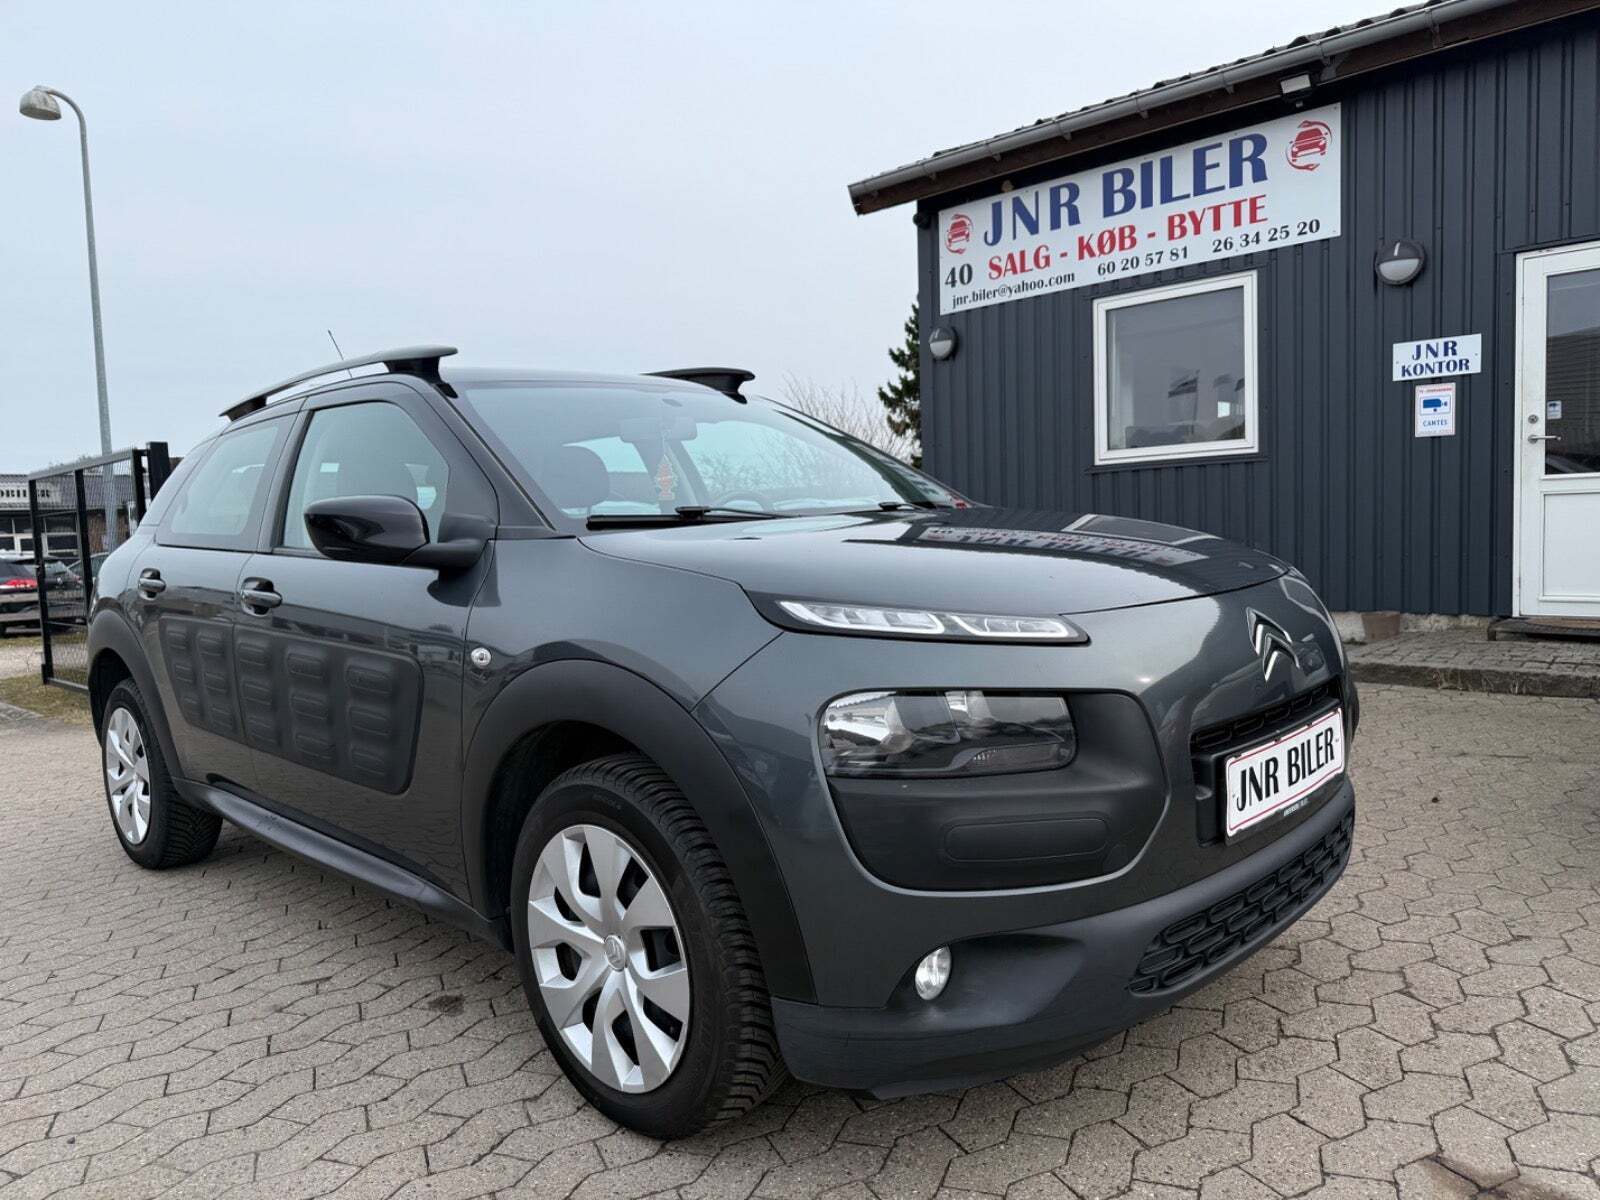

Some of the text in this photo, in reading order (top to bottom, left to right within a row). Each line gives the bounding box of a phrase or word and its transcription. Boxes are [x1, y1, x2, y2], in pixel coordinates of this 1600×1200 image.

[984, 133, 1268, 246] JNR BILER
[988, 244, 1051, 280] SALG
[1077, 224, 1137, 261] KØB
[1167, 194, 1269, 241] BYTTE
[1212, 219, 1320, 253] 26 34 25 20
[945, 263, 973, 288] 40
[1097, 246, 1188, 276] 60 20 57 81
[952, 272, 1075, 308] jnr.biler@yahoo.com
[1412, 340, 1457, 360] JNR
[1401, 358, 1470, 377] KONTOR
[1236, 727, 1335, 812] JNR BILER
